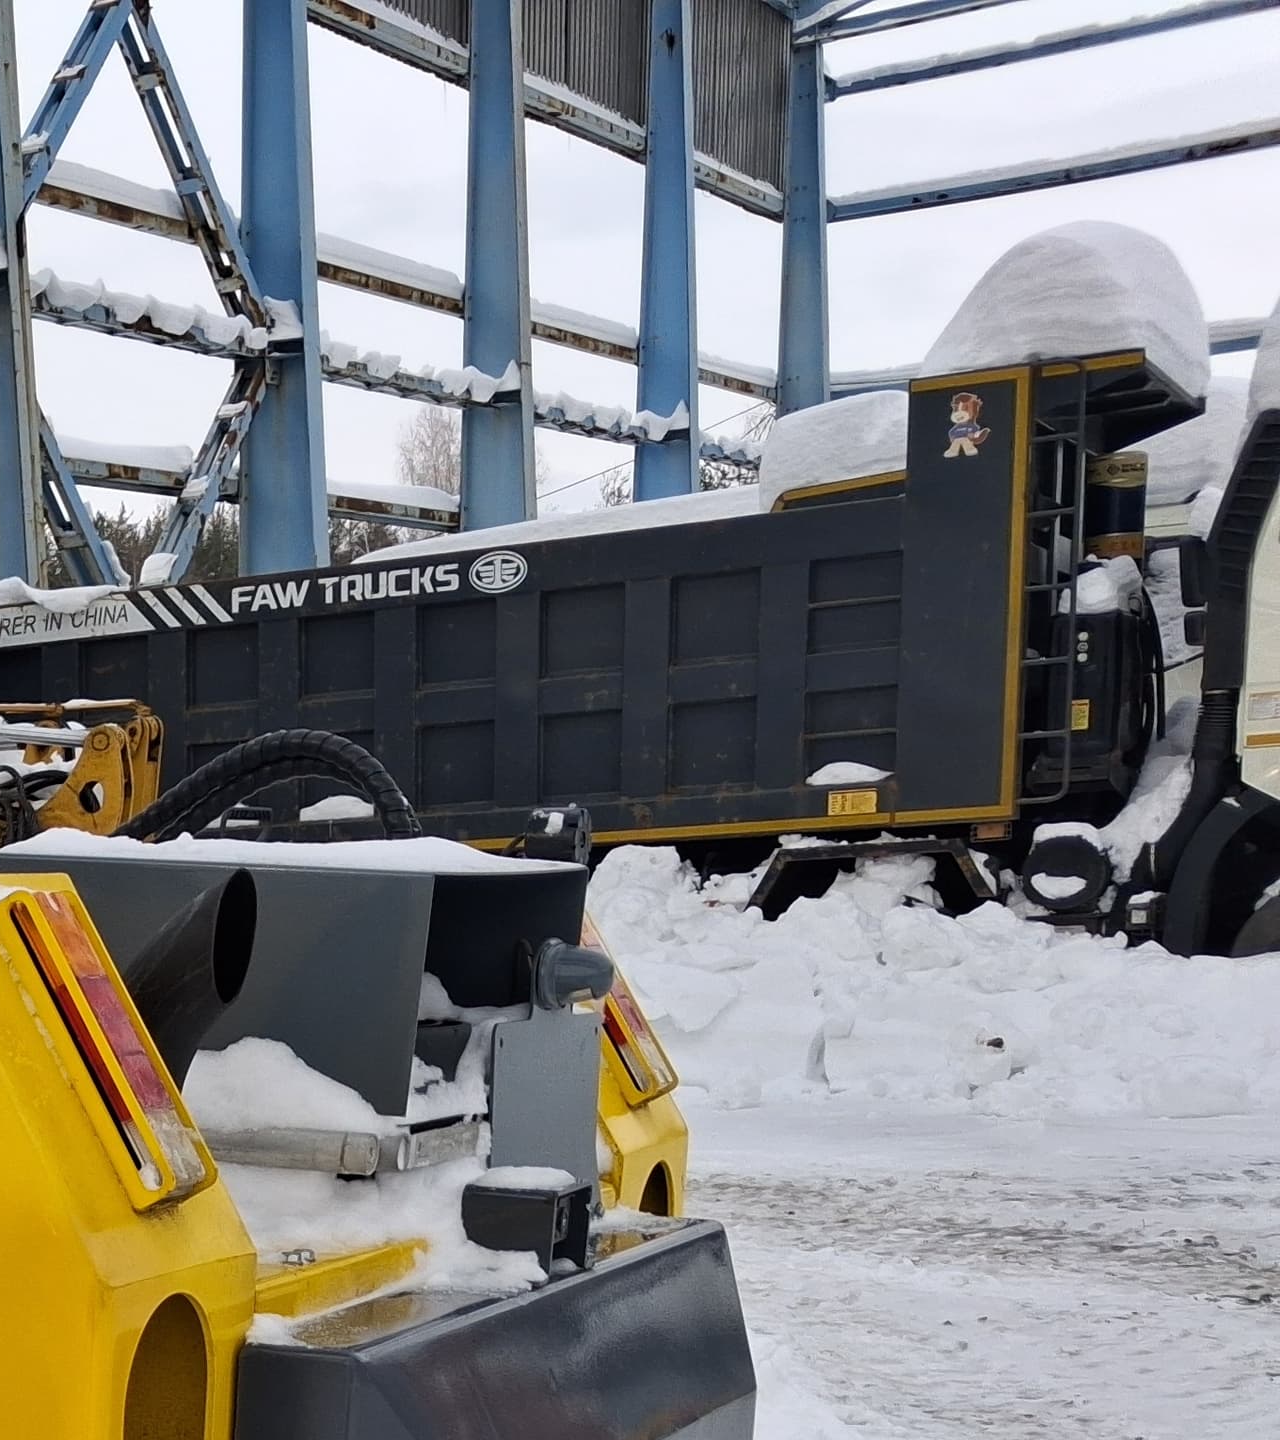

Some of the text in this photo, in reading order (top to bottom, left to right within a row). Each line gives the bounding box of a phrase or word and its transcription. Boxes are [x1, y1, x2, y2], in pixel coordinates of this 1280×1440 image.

[230, 563, 460, 614] FAW TRUCKS
[43, 612, 63, 633] IN
[70, 603, 129, 629] CHINA
